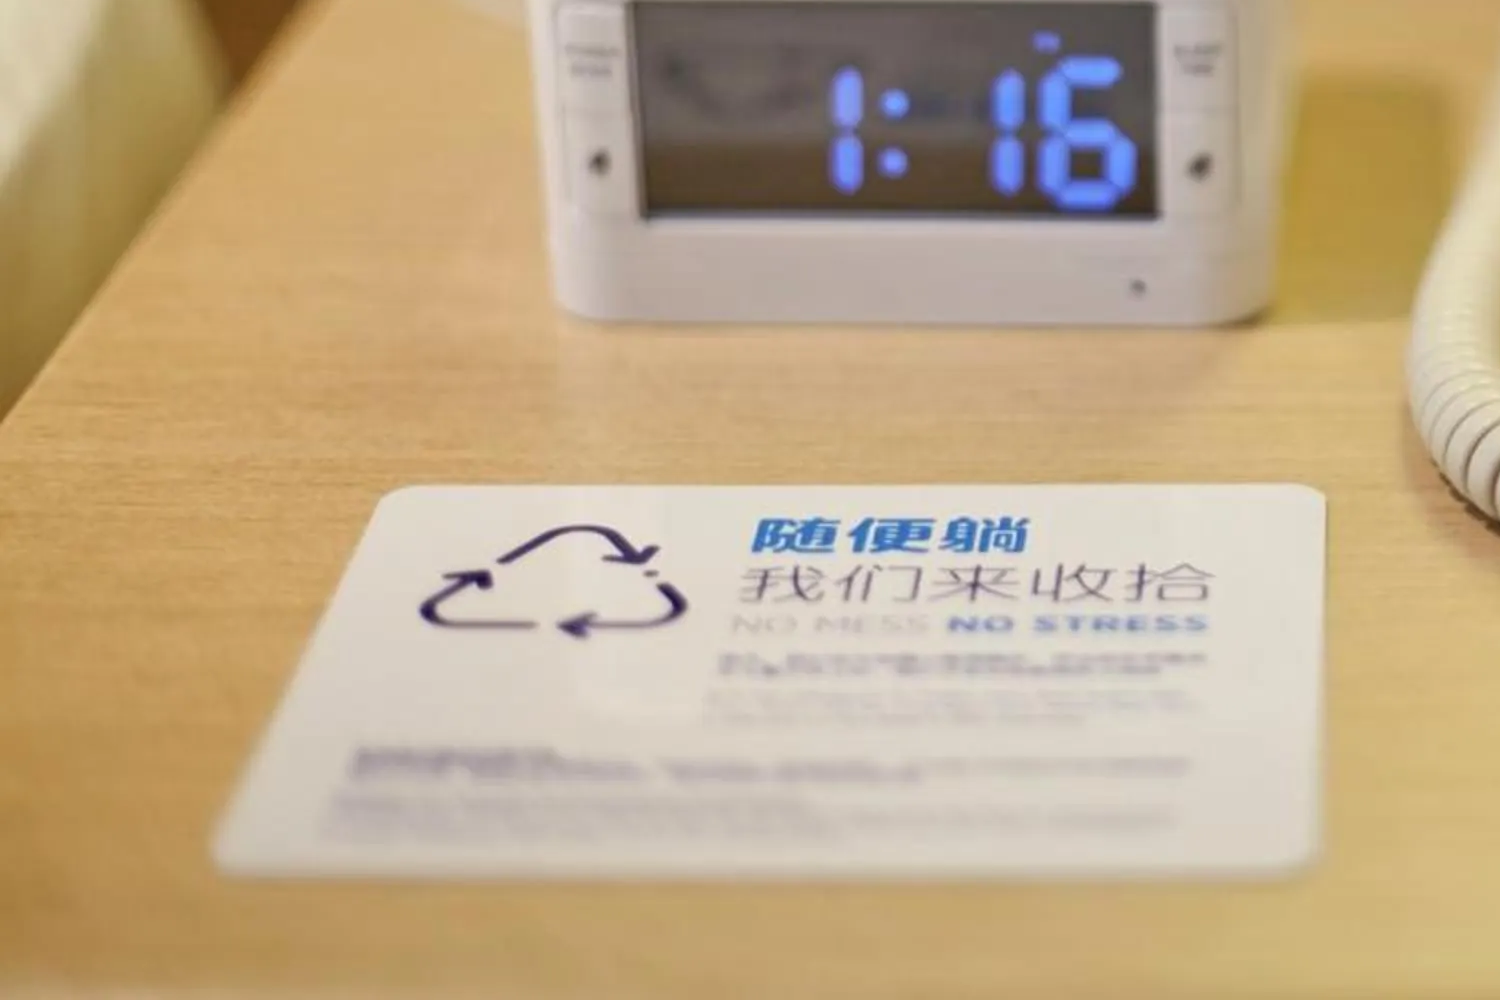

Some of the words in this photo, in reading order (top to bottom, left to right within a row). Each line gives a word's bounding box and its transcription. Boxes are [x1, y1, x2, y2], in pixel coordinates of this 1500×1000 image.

[750, 517, 1031, 554] 随便躺
[739, 562, 1217, 603] 我们来收拾
[946, 613, 1015, 635] NO
[1033, 613, 1210, 635] STRESS
